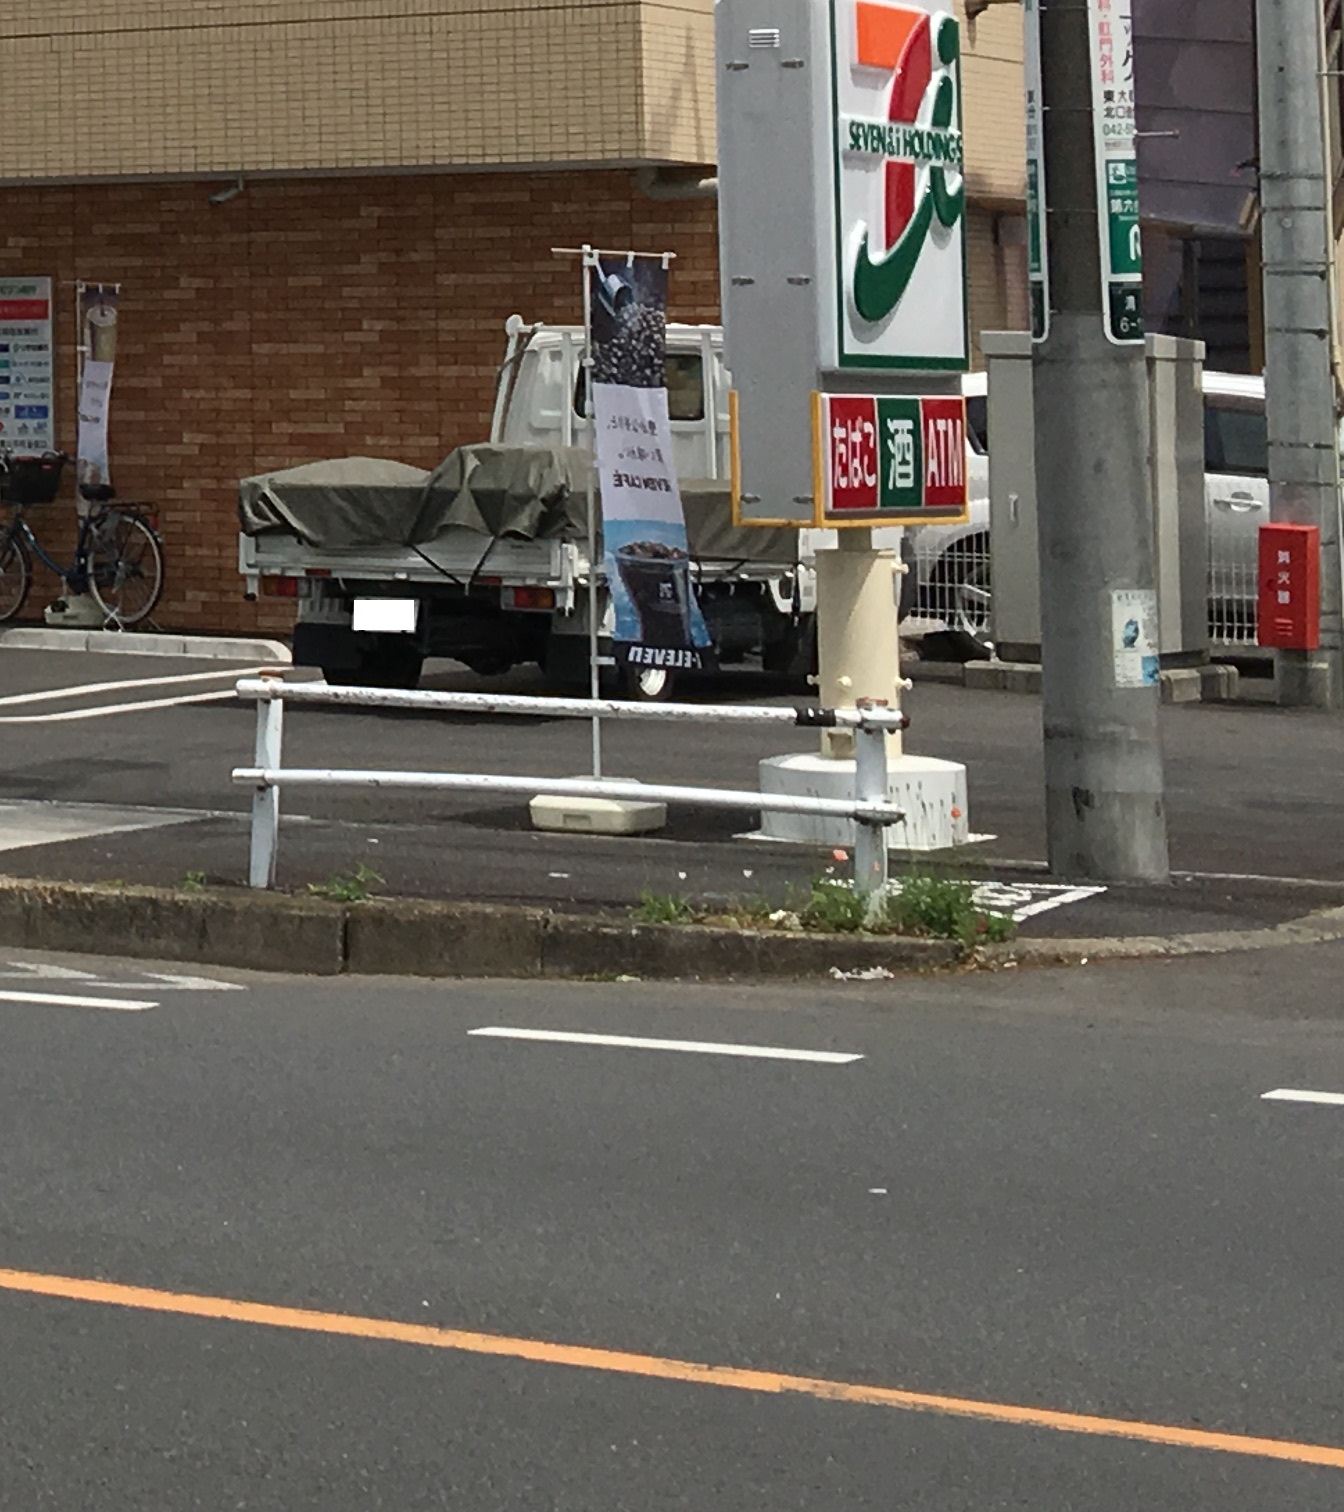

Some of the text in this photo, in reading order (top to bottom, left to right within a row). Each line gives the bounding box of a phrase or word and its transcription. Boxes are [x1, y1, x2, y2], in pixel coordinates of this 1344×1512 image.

[832, 415, 964, 490] たばこ 酒 ATM
